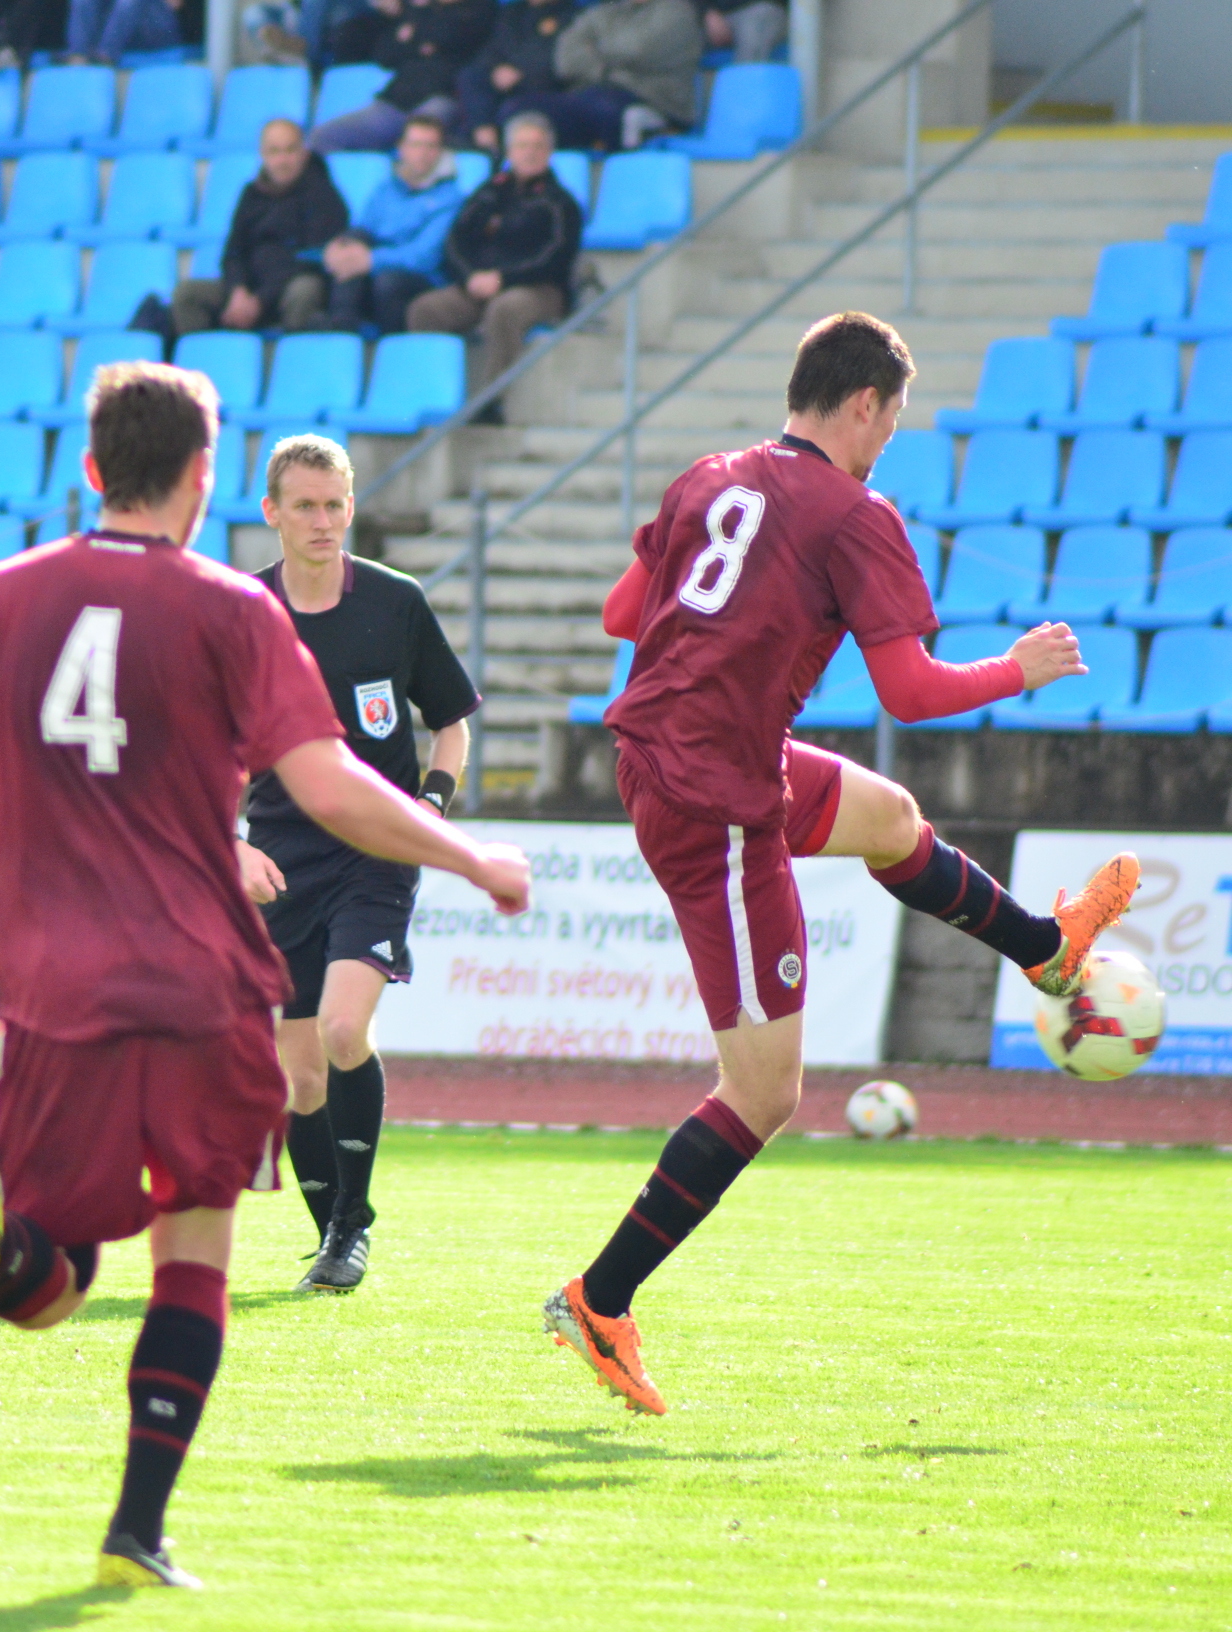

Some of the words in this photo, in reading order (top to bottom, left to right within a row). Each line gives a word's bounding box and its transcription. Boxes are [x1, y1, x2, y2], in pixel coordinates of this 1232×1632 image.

[679, 485, 765, 614] 8
[40, 605, 128, 773] 4
[558, 911, 572, 940] a
[448, 957, 538, 996] Přední
[547, 961, 654, 1009] světový
[478, 1015, 634, 1057] obráběcích
